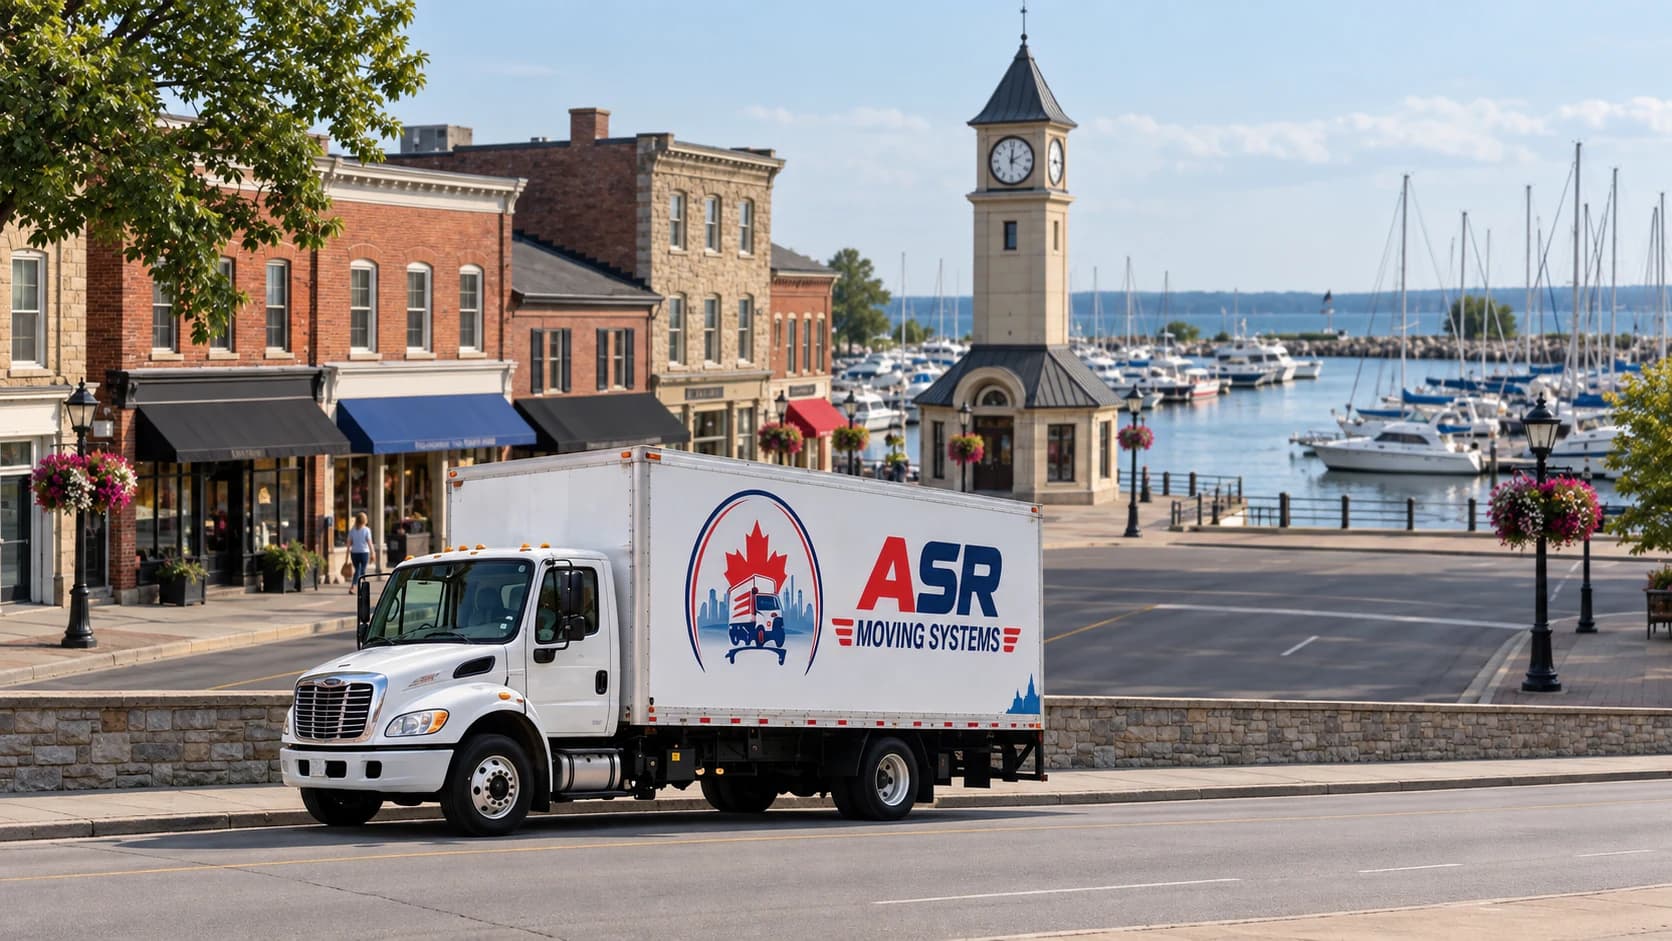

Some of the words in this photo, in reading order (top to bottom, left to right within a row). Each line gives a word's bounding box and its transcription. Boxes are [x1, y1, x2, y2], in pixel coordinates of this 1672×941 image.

[856, 536, 1002, 617] ASR
[856, 620, 924, 649] MOVING
[929, 624, 1000, 652] SYSTEMS
